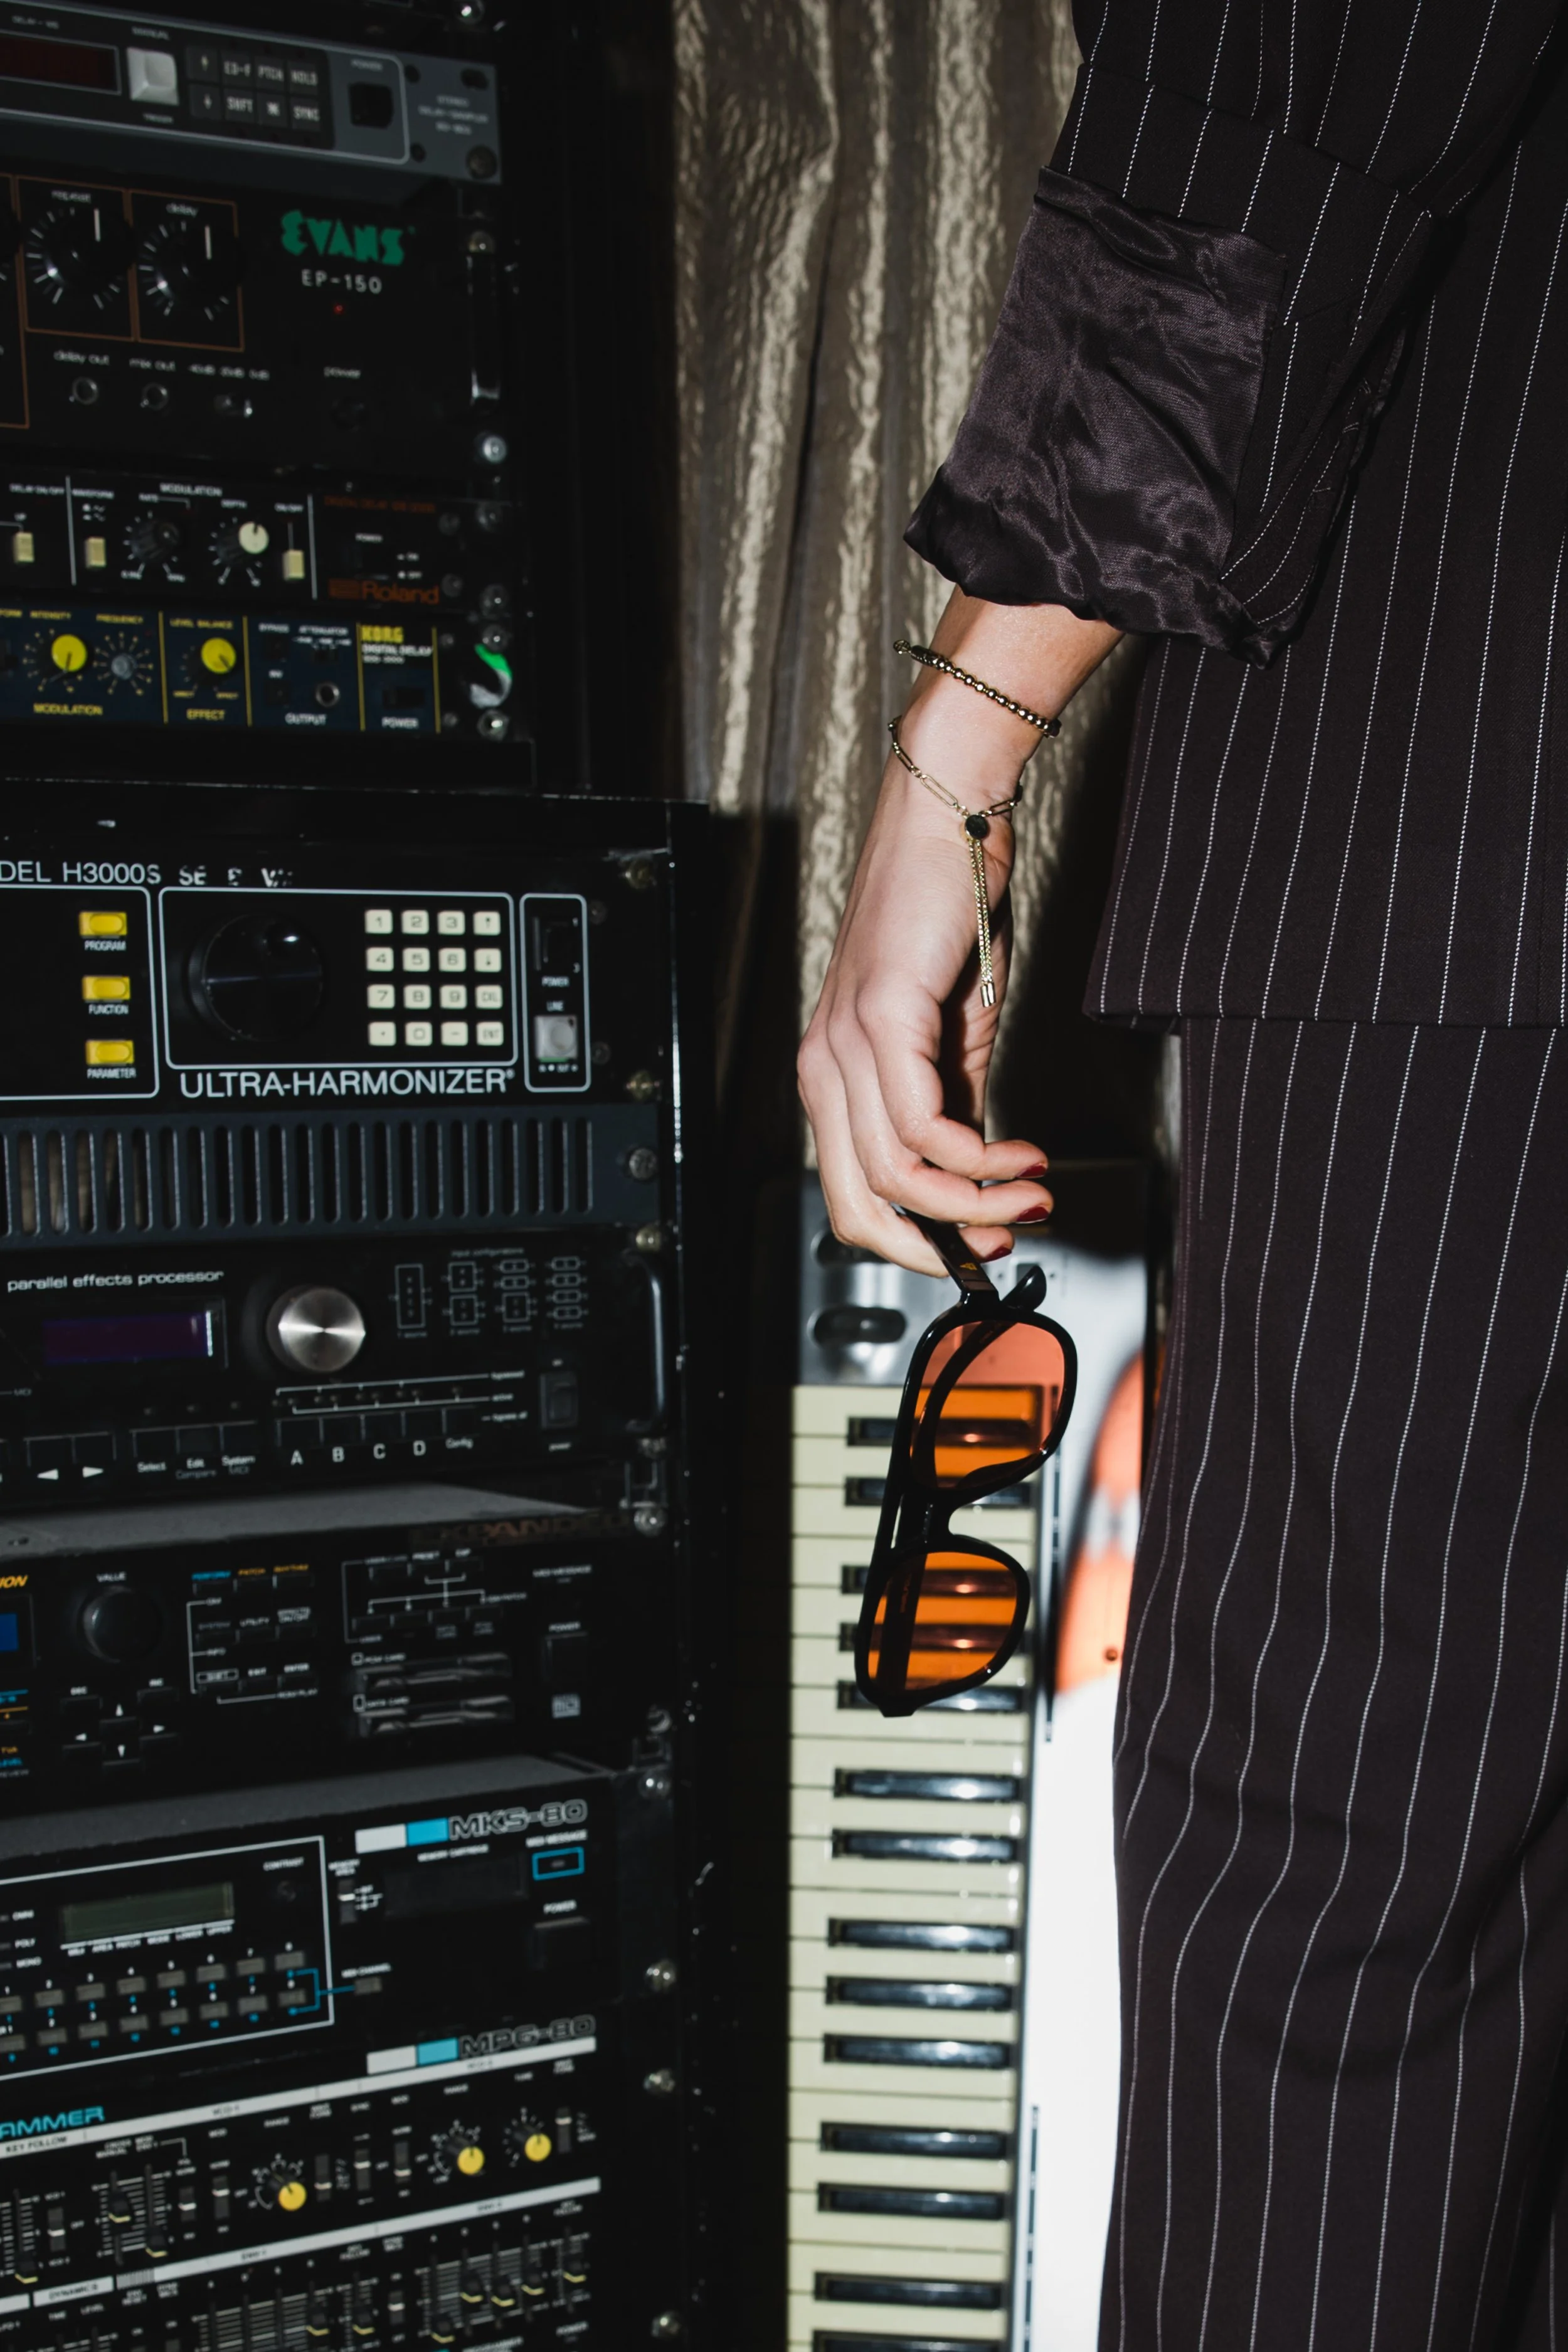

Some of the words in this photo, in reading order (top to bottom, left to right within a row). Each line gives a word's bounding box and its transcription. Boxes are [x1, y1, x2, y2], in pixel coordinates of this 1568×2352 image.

[280, 209, 405, 267] EVANS
[300, 268, 383, 295] EP-150
[154, 359, 177, 372] out
[159, 482, 223, 497] MODULATION
[362, 579, 440, 606] Roland
[361, 625, 405, 644] KORG
[33, 702, 103, 716] MODULATION
[186, 708, 226, 721] EFFECT
[284, 711, 327, 726] OUTPUT
[381, 716, 420, 729] POWER
[62, 861, 162, 885] H3000S
[411, 916, 423, 928] 2
[446, 917, 458, 928] 3
[84, 940, 127, 951] PROGRAM
[376, 953, 387, 965] 4
[411, 953, 423, 965] 5
[447, 954, 458, 965] 6
[542, 976, 569, 988] POWER
[377, 990, 388, 1002] 7
[413, 991, 425, 1002] 8
[449, 991, 460, 1003] 9
[88, 1004, 129, 1015] FUNCTION
[546, 1000, 564, 1012] LINE
[87, 1067, 136, 1079] PARAMETER
[7, 1275, 68, 1293] parallel
[72, 1273, 134, 1288] effects
[137, 1270, 225, 1287] processor
[332, 1446, 346, 1463] B
[373, 1443, 386, 1460] C
[413, 1440, 426, 1457] D
[186, 1458, 205, 1469] Edit
[221, 1454, 256, 1467] System
[290, 1449, 304, 1466] A
[137, 1461, 167, 1473] Select
[96, 1571, 127, 1583] VALUE
[448, 1798, 588, 1841] MKS-80
[263, 1856, 305, 1872] CONTRAST
[543, 1899, 578, 1915] POWER
[14, 1937, 36, 1949] POLY
[16, 1956, 42, 1969] MONO
[458, 2013, 596, 2059] MPG-80
[0, 2105, 105, 2139] AMMER
[263, 2116, 291, 2129] RANGE
[5, 2143, 24, 2154] KEY
[28, 2136, 68, 2149] FOLLOW
[48, 2311, 66, 2321] TIME
[80, 2303, 105, 2316] LEVEL
